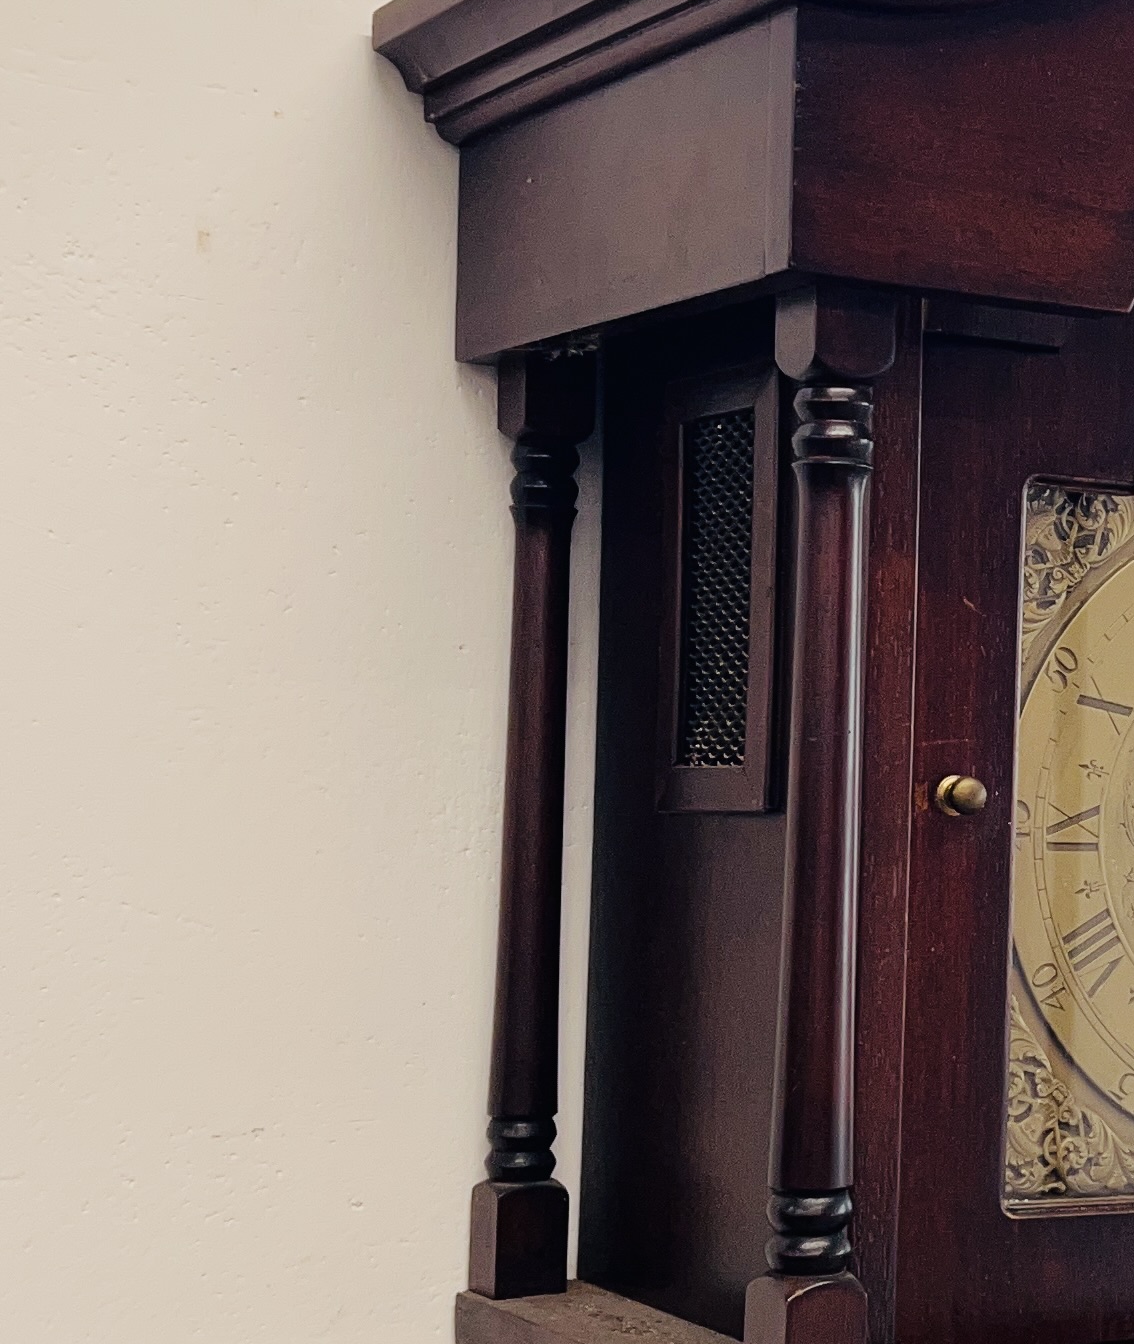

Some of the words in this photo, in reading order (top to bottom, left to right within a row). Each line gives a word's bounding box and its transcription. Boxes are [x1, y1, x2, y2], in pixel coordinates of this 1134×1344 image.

[1045, 647, 1078, 694] 50
[1076, 676, 1133, 735] X
[1046, 802, 1100, 851] IX
[1062, 908, 1125, 998] VIII
[1032, 963, 1066, 1012] 40
